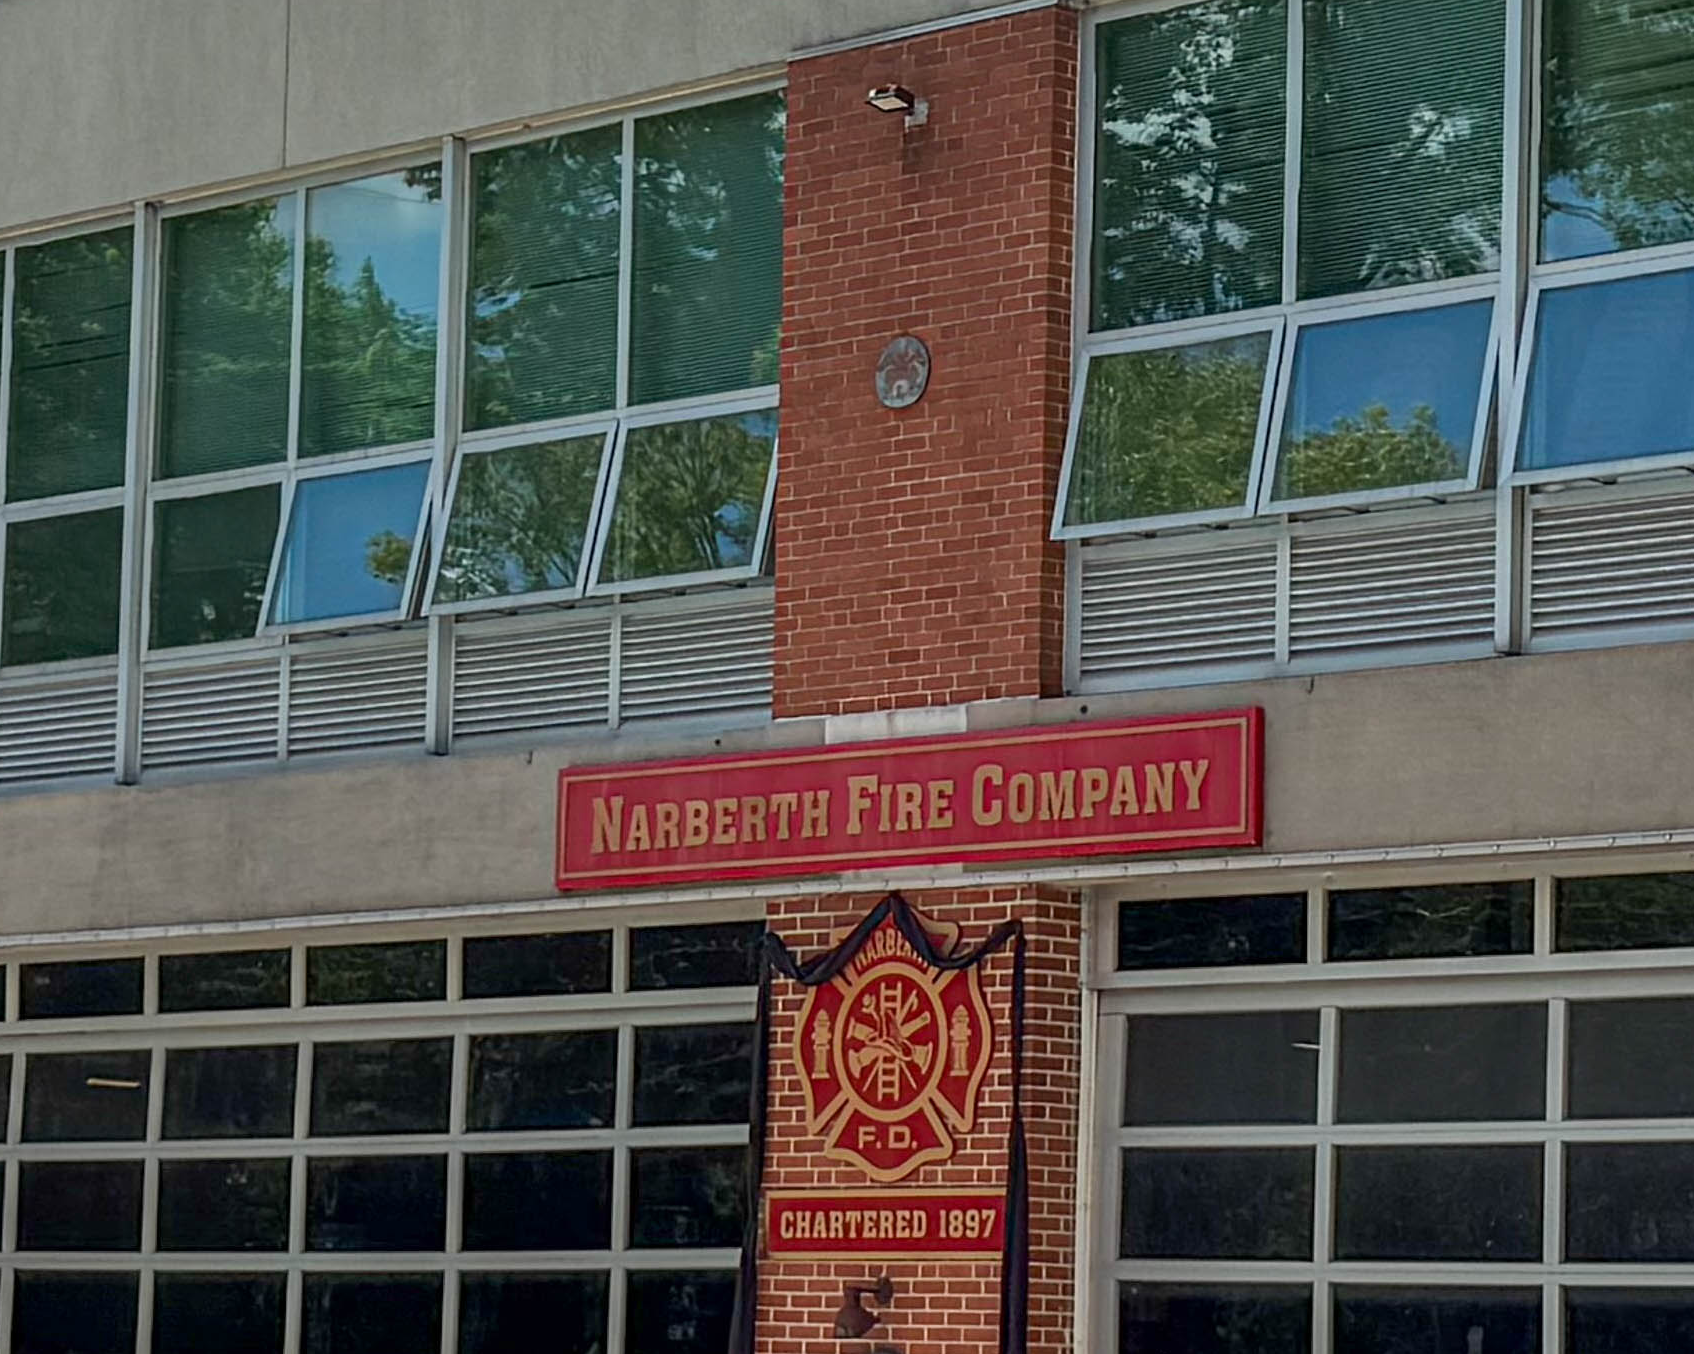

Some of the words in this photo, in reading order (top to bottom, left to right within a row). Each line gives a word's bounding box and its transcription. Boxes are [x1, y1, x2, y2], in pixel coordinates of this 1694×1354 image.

[846, 775, 955, 836] FIRE
[971, 759, 1209, 826] COMPANY
[780, 1209, 928, 1240] CHARTERED
[939, 1207, 997, 1239] 1897
